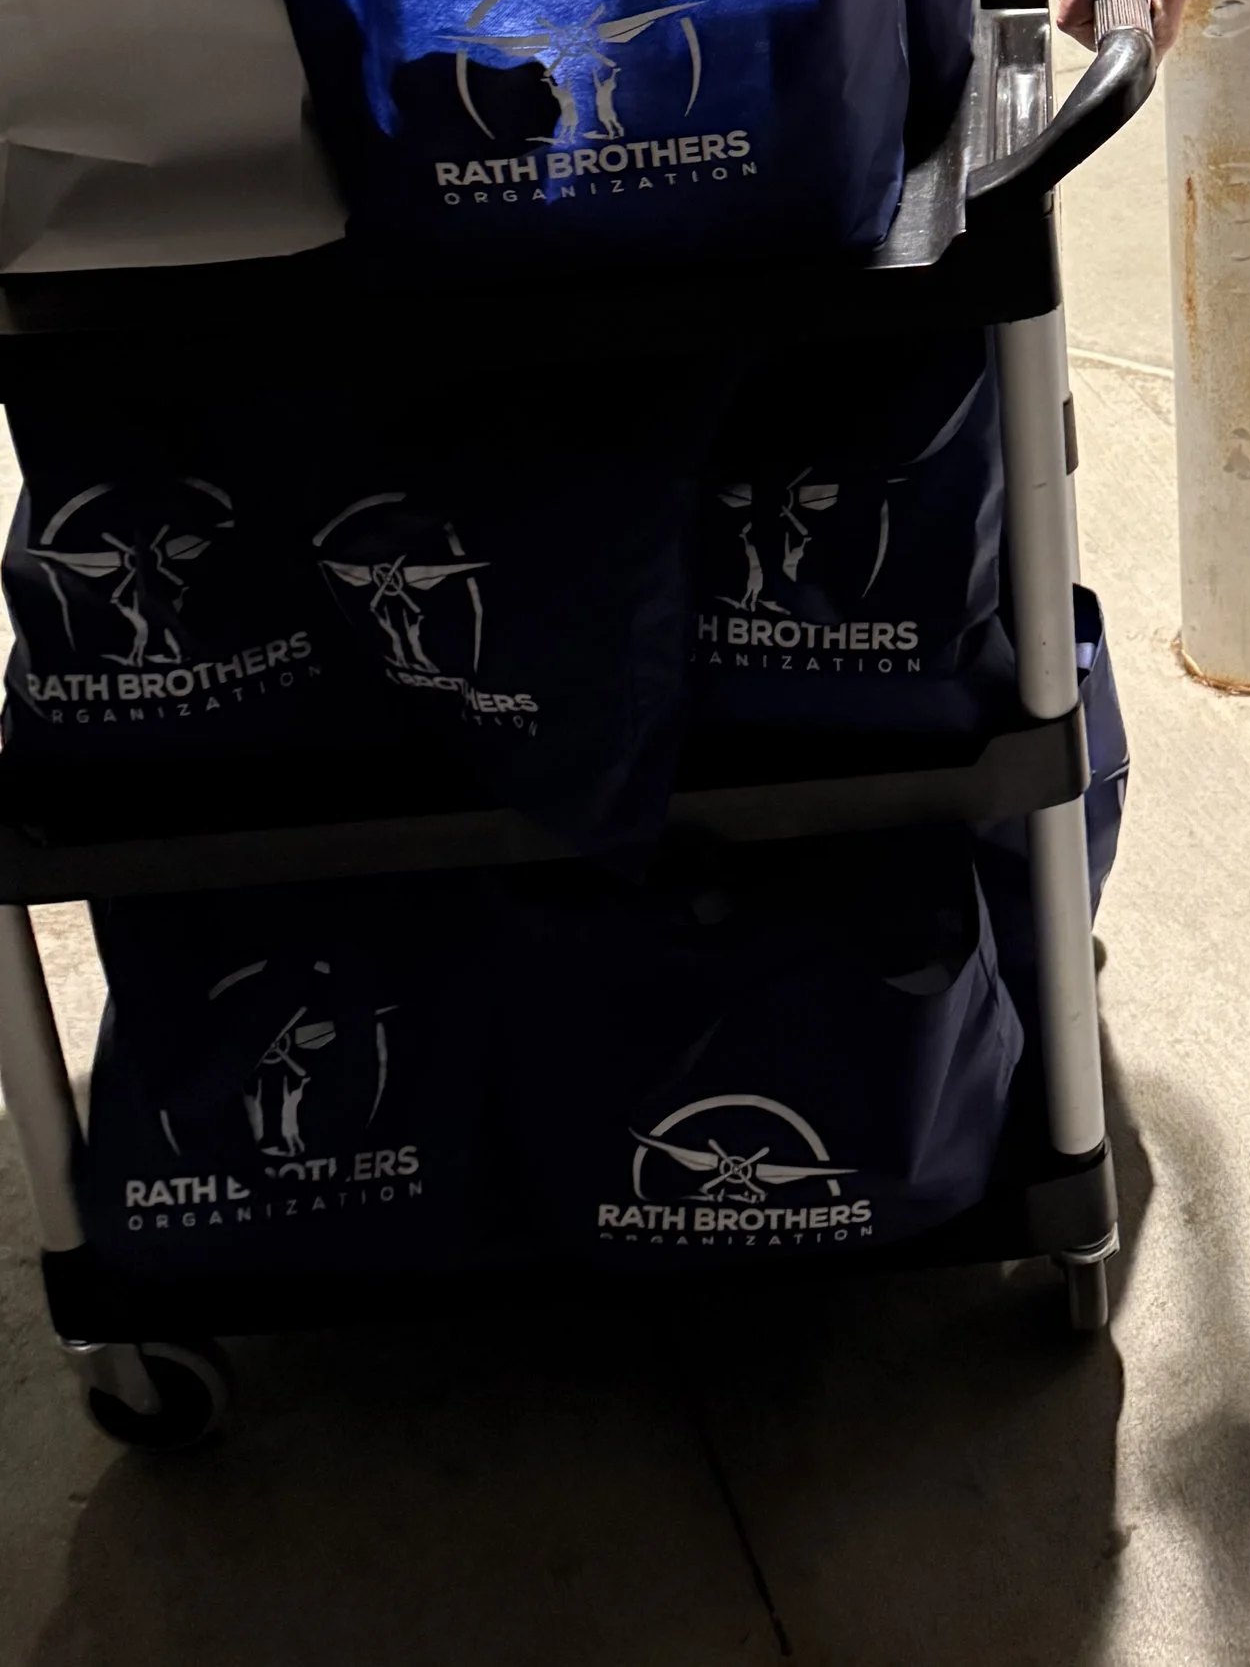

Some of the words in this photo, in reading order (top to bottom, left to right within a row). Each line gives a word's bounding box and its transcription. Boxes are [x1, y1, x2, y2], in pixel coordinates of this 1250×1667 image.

[435, 156, 538, 185] RATH
[546, 130, 750, 180] BROTHERS
[444, 161, 757, 206] ORGANIZATION
[727, 617, 919, 651] BROTHERS
[118, 631, 312, 700] BROTHERS
[690, 651, 921, 673] ANIZATION
[52, 664, 321, 723] RGANIZATION
[125, 1175, 216, 1207] RATH
[128, 1180, 422, 1231] ORGANIZATION
[598, 1204, 685, 1231] RATH
[694, 1199, 872, 1232] BROTHERS
